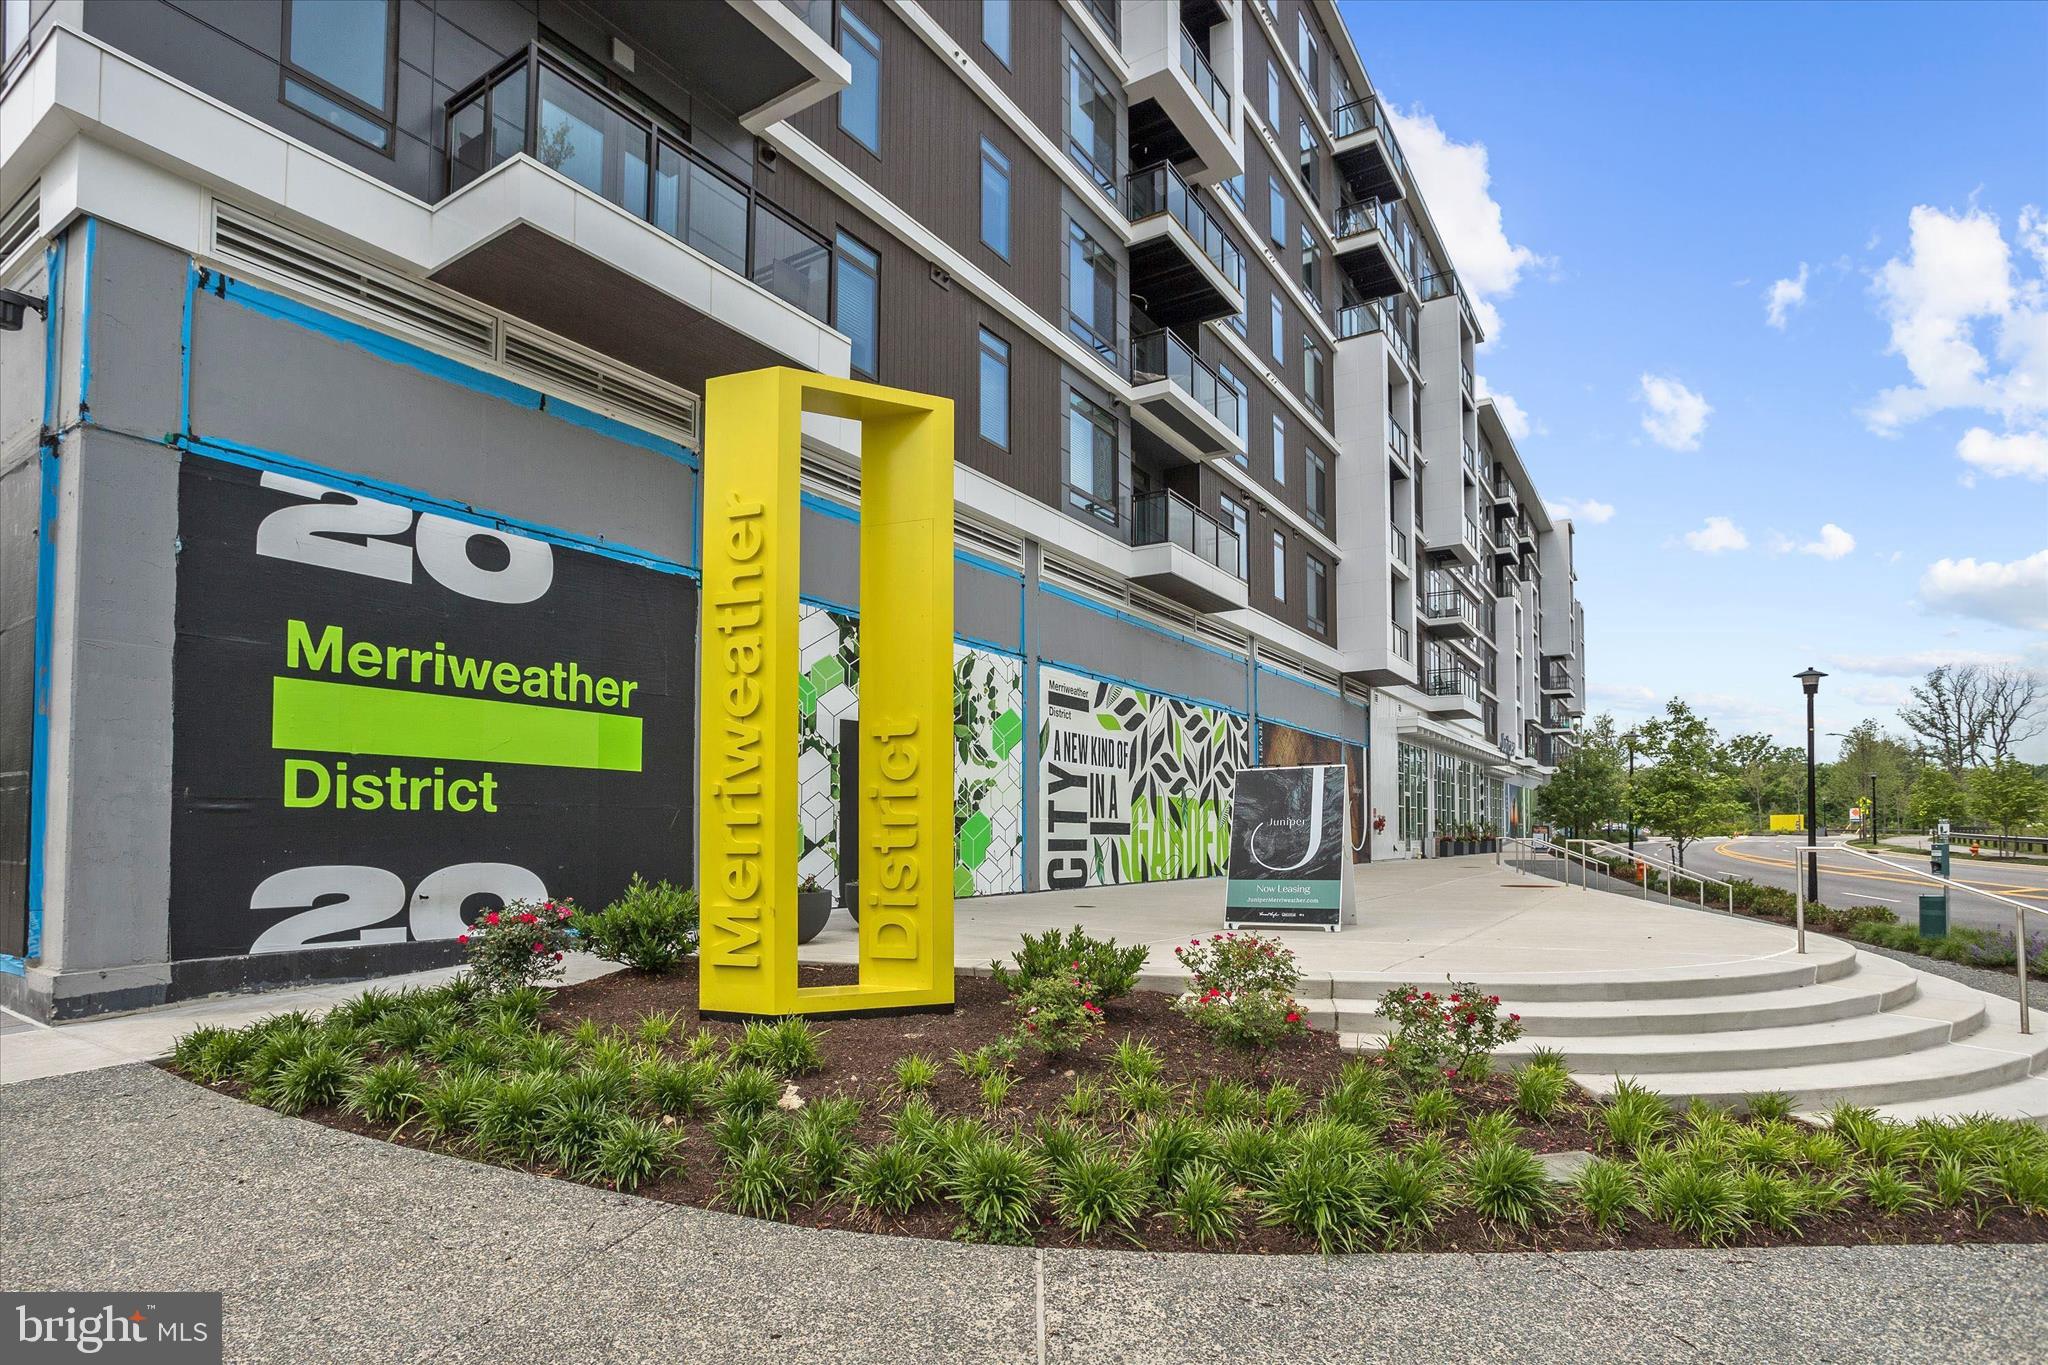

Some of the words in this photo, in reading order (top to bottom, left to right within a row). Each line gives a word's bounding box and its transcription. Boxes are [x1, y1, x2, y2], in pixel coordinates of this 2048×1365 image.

[257, 470, 554, 604] 20
[287, 618, 639, 709] Merriweather
[1048, 679, 1089, 699] Merriweather
[712, 492, 765, 970] Merriweather
[1048, 706, 1072, 720] District
[1053, 729, 1061, 761] A
[1063, 731, 1089, 765] NEW
[1091, 735, 1115, 768] KIND
[1117, 740, 1129, 770] OF
[284, 758, 499, 814] District
[1090, 772, 1106, 819] IN
[1108, 775, 1119, 819] A
[868, 714, 919, 961] District
[1047, 761, 1088, 891] CITY
[1266, 817, 1306, 829] Juniper
[248, 861, 550, 955] 20
[1256, 884, 1275, 893] Now
[1277, 884, 1312, 895] Leasing
